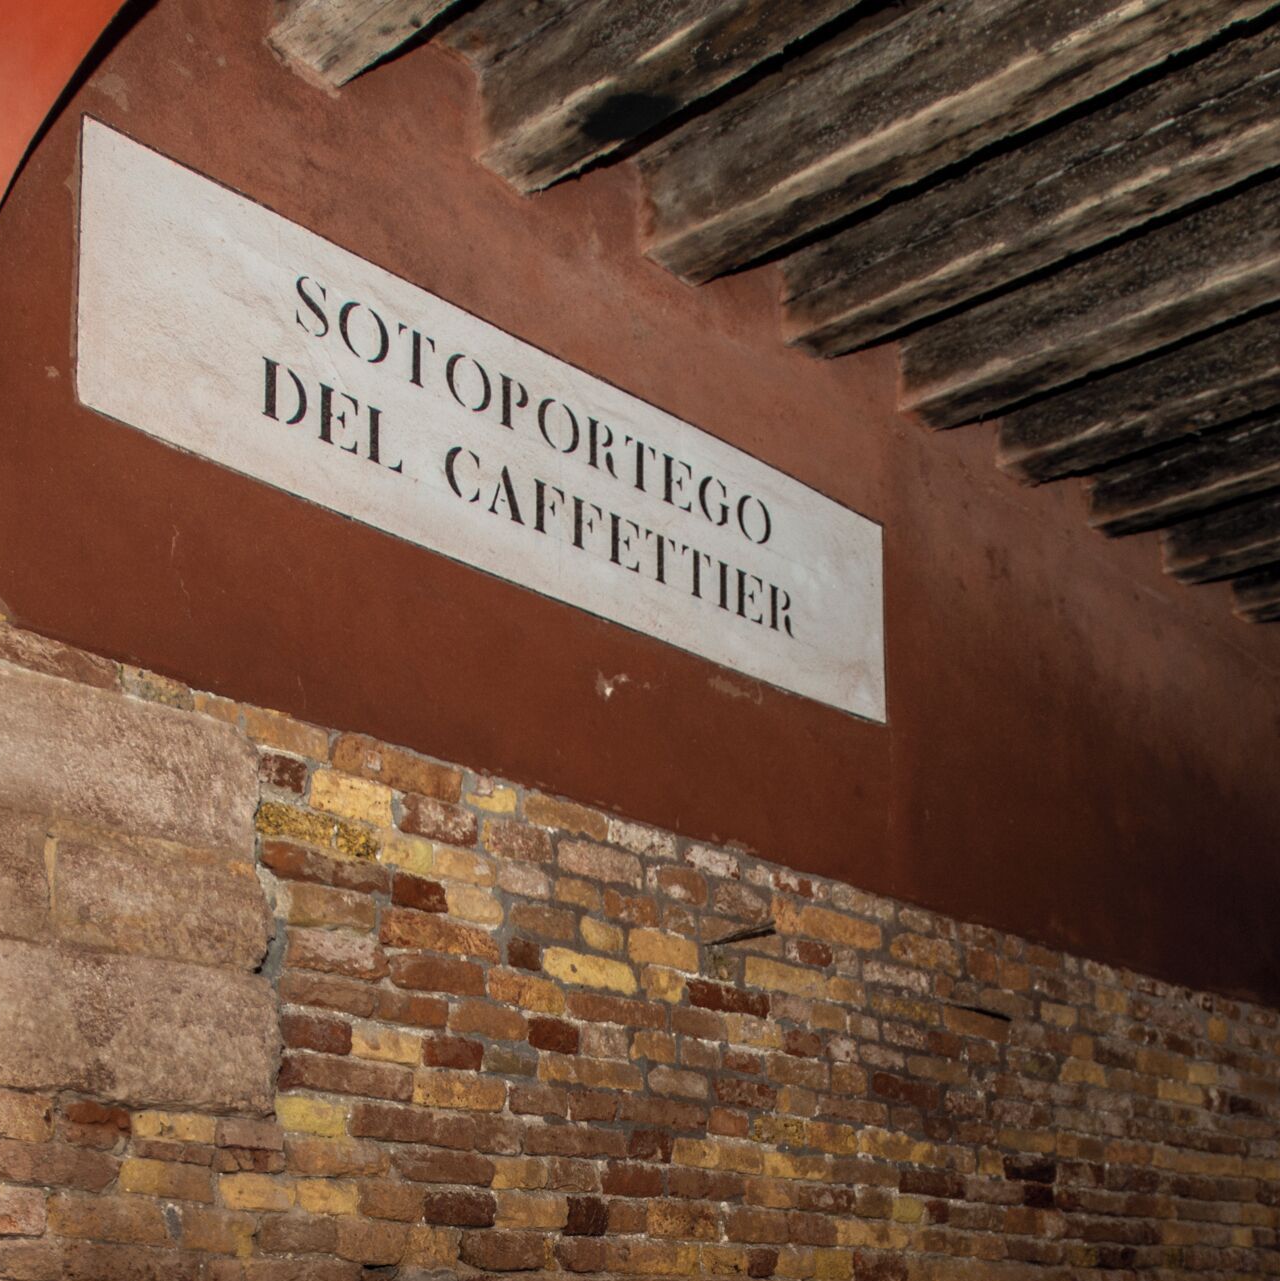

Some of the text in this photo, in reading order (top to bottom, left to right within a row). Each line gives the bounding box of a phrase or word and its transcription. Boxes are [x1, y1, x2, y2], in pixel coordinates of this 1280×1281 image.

[261, 355, 795, 639] DEL CAFFETTIER
[295, 275, 772, 545] SOTOPORTEGO
